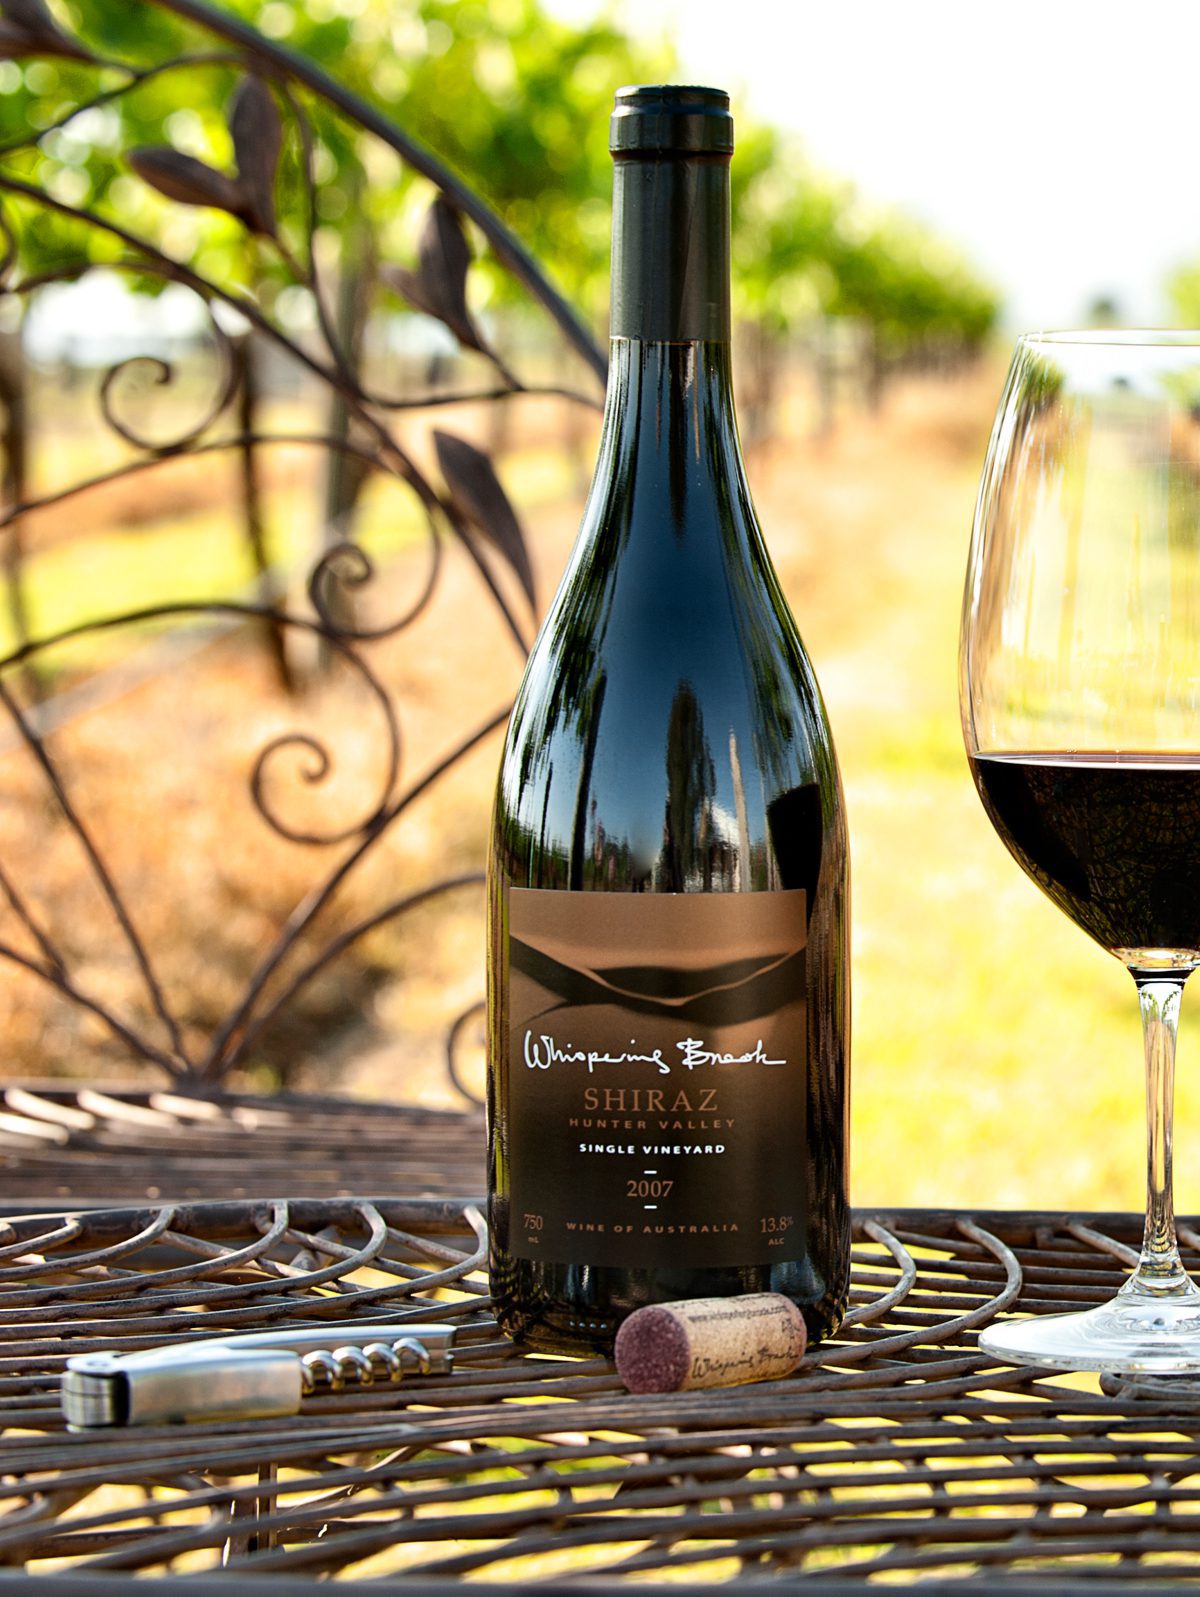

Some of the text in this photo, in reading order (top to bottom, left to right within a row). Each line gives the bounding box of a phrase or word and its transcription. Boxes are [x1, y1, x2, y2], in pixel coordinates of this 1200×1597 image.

[523, 1030, 671, 1074] Whispering
[584, 1087, 718, 1112] SHIRAZ
[569, 1117, 736, 1130] HUNTER VALLEY
[579, 1143, 726, 1155] SINGLE VINEYARD
[626, 1179, 674, 1198] 2007
[523, 1213, 544, 1230] 750
[566, 1221, 740, 1233] WINE OF AUSTRALIA
[767, 1237, 786, 1246] ALC
